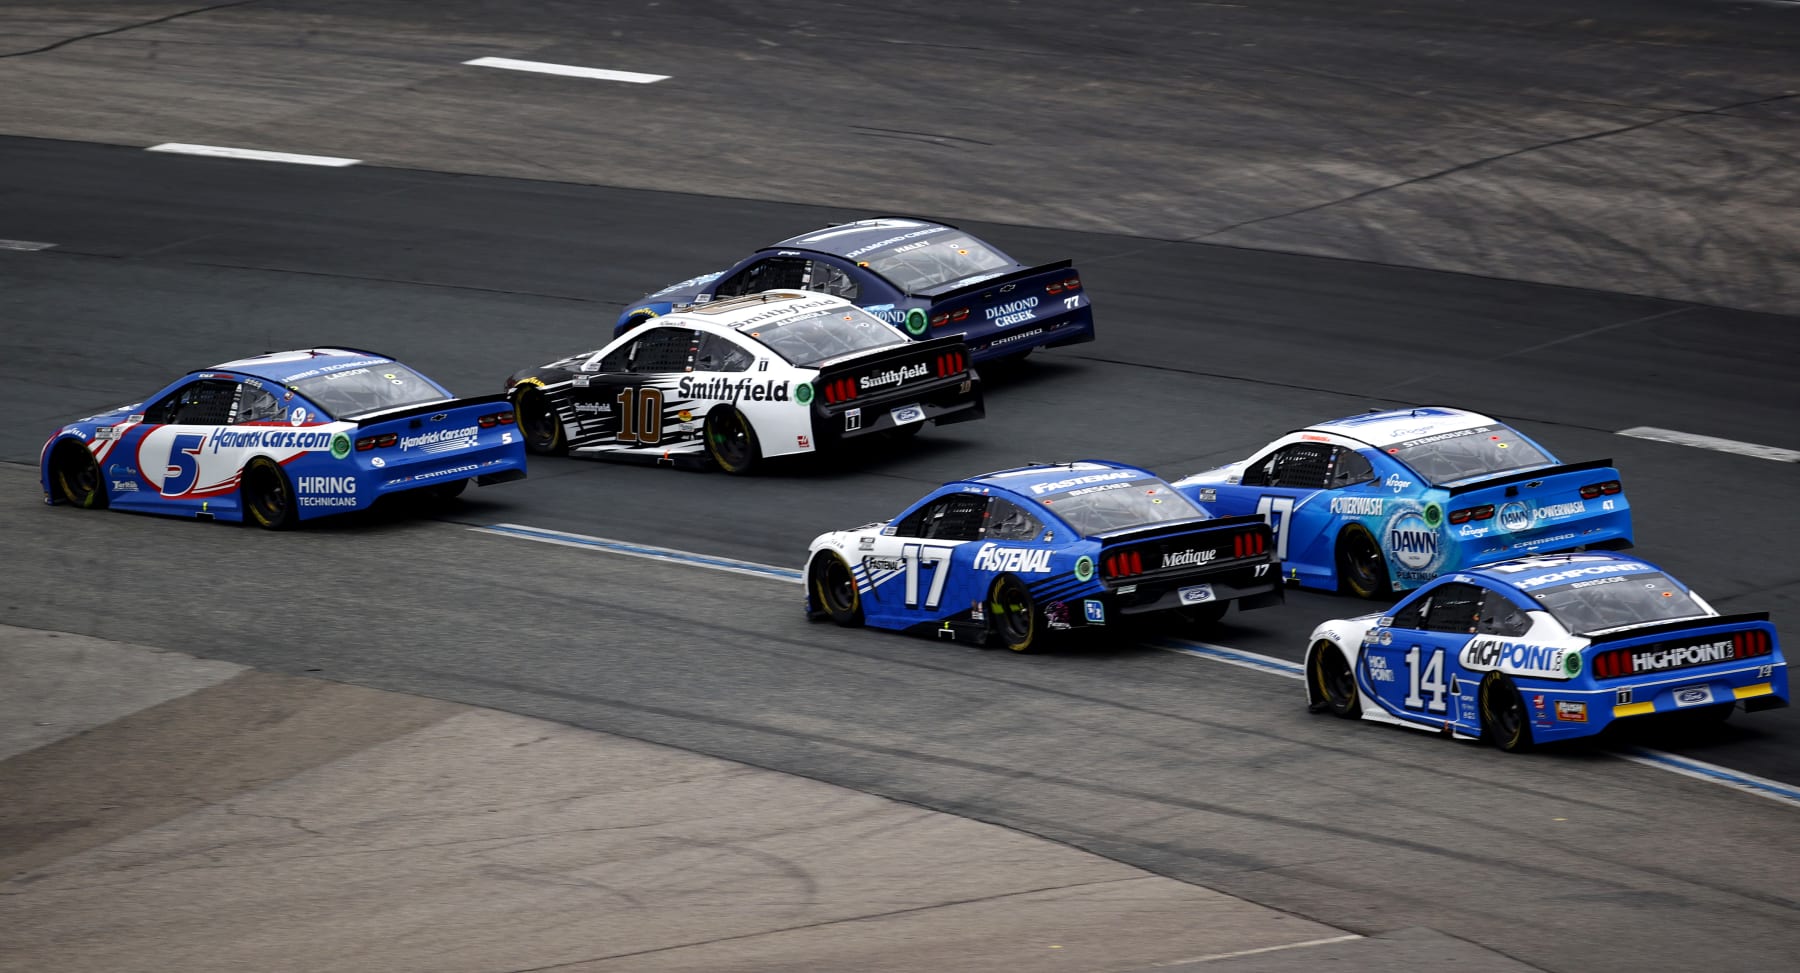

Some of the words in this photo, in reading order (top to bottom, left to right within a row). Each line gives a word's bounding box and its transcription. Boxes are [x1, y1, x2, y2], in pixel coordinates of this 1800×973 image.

[846, 236, 905, 259] DIAMOND
[894, 241, 930, 254] HALEY
[985, 296, 1039, 320] DIAMOND
[1064, 295, 1080, 310] 77
[727, 299, 838, 330] Smithfield
[995, 309, 1037, 327] CREEK
[991, 327, 1043, 347] CAMARO
[282, 368, 320, 383] HIRING
[324, 367, 370, 380] LARSON
[860, 362, 929, 390] Smithfield
[678, 376, 790, 408] Smithfield
[574, 401, 612, 415] Smithfield
[616, 387, 664, 444] 10
[501, 432, 513, 445] 5
[1402, 429, 1474, 449] STENHOUSE
[160, 432, 206, 498] 5
[414, 464, 479, 481] CAMARO
[298, 476, 356, 494] HIRING
[1030, 471, 1137, 495] FASTENAL
[1386, 473, 1411, 494] Kroger
[299, 496, 357, 507] TECHNICIANS
[1330, 497, 1383, 516] POWERWASH
[1532, 501, 1585, 521] POWERWASH
[1501, 511, 1529, 526] DAWN
[1458, 524, 1489, 539] Kroger
[1513, 533, 1575, 549] CAMARO
[1391, 529, 1438, 555] DAWN
[869, 556, 901, 572] FASTENAL
[973, 542, 1056, 573] FASTENAL
[1161, 548, 1217, 569] Médique
[902, 543, 955, 608] 17
[1254, 563, 1270, 578] 17
[1570, 576, 1628, 589] BRISCOE
[1188, 590, 1206, 601] Ford
[1467, 639, 1558, 672] HIGHPOINT
[1632, 642, 1728, 673] HIGHPOINT
[1405, 646, 1447, 713] 14
[1757, 664, 1773, 678] 14
